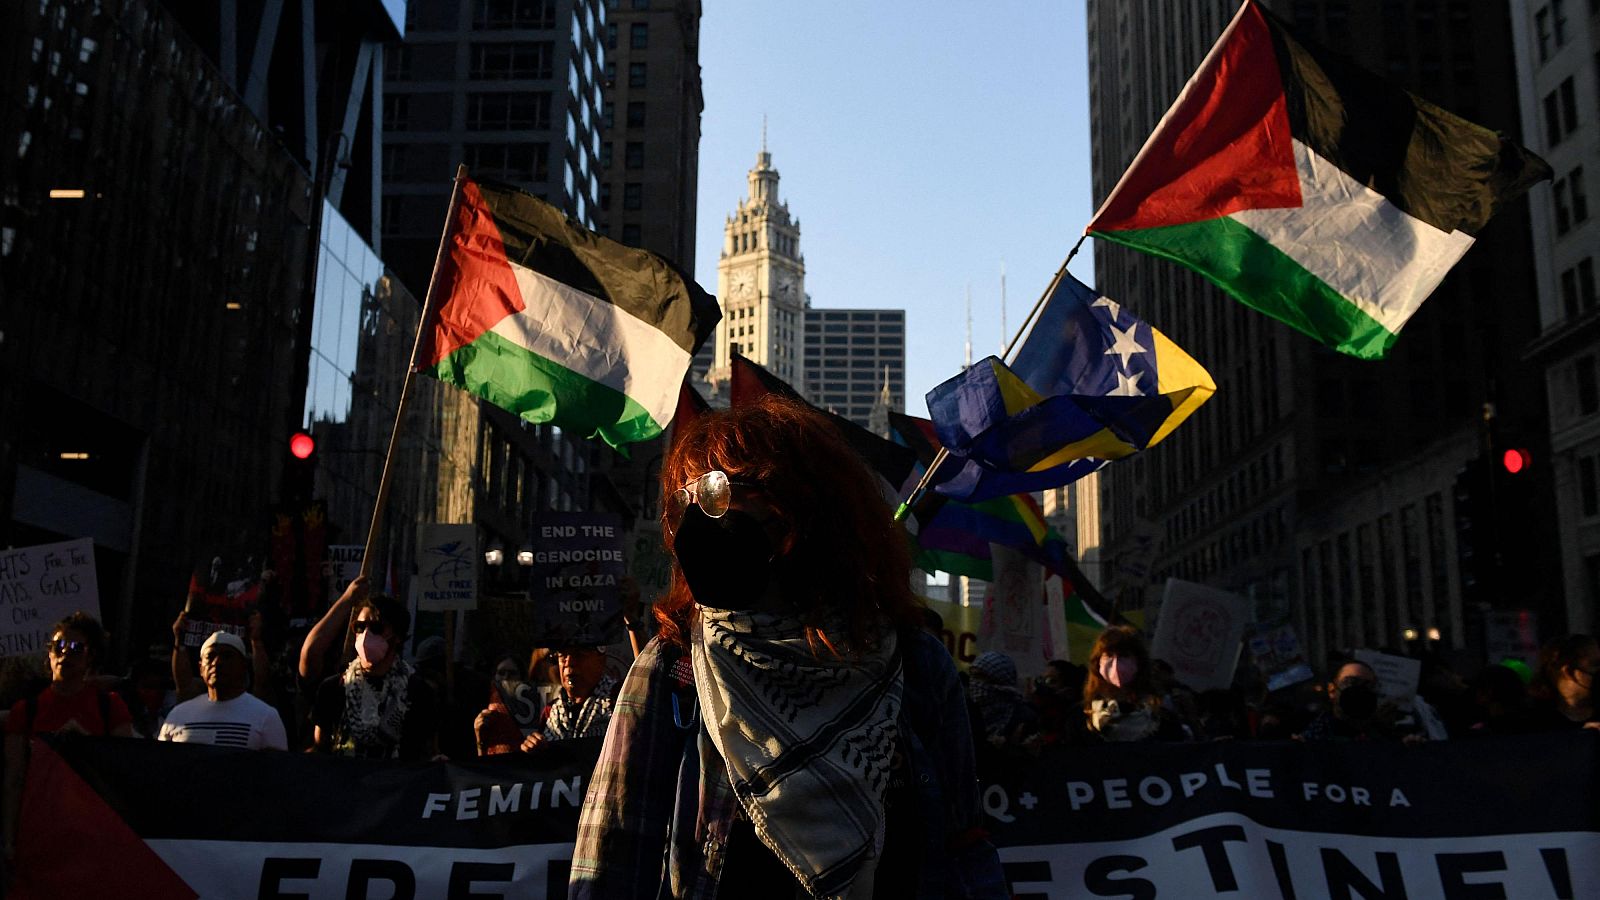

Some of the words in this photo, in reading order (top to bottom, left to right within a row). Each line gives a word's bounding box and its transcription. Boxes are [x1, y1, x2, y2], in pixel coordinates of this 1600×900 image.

[541, 525, 577, 538] END
[581, 525, 615, 538] THE
[329, 549, 364, 561] ALIZ
[536, 549, 623, 563] GENOCIDE
[40, 573, 80, 596] GALS
[448, 580, 472, 589] FREE
[545, 576, 563, 589] IN
[568, 573, 616, 588] GAZA
[424, 591, 473, 600] PALESTINE
[560, 600, 605, 613] NOW!
[421, 775, 581, 821] FEMIN
[982, 784, 1039, 823] Q+
[1066, 763, 1275, 811] PEOPLE
[1302, 781, 1373, 807] FOR
[1389, 787, 1413, 808] A
[1002, 825, 1573, 900] ESTINE!
